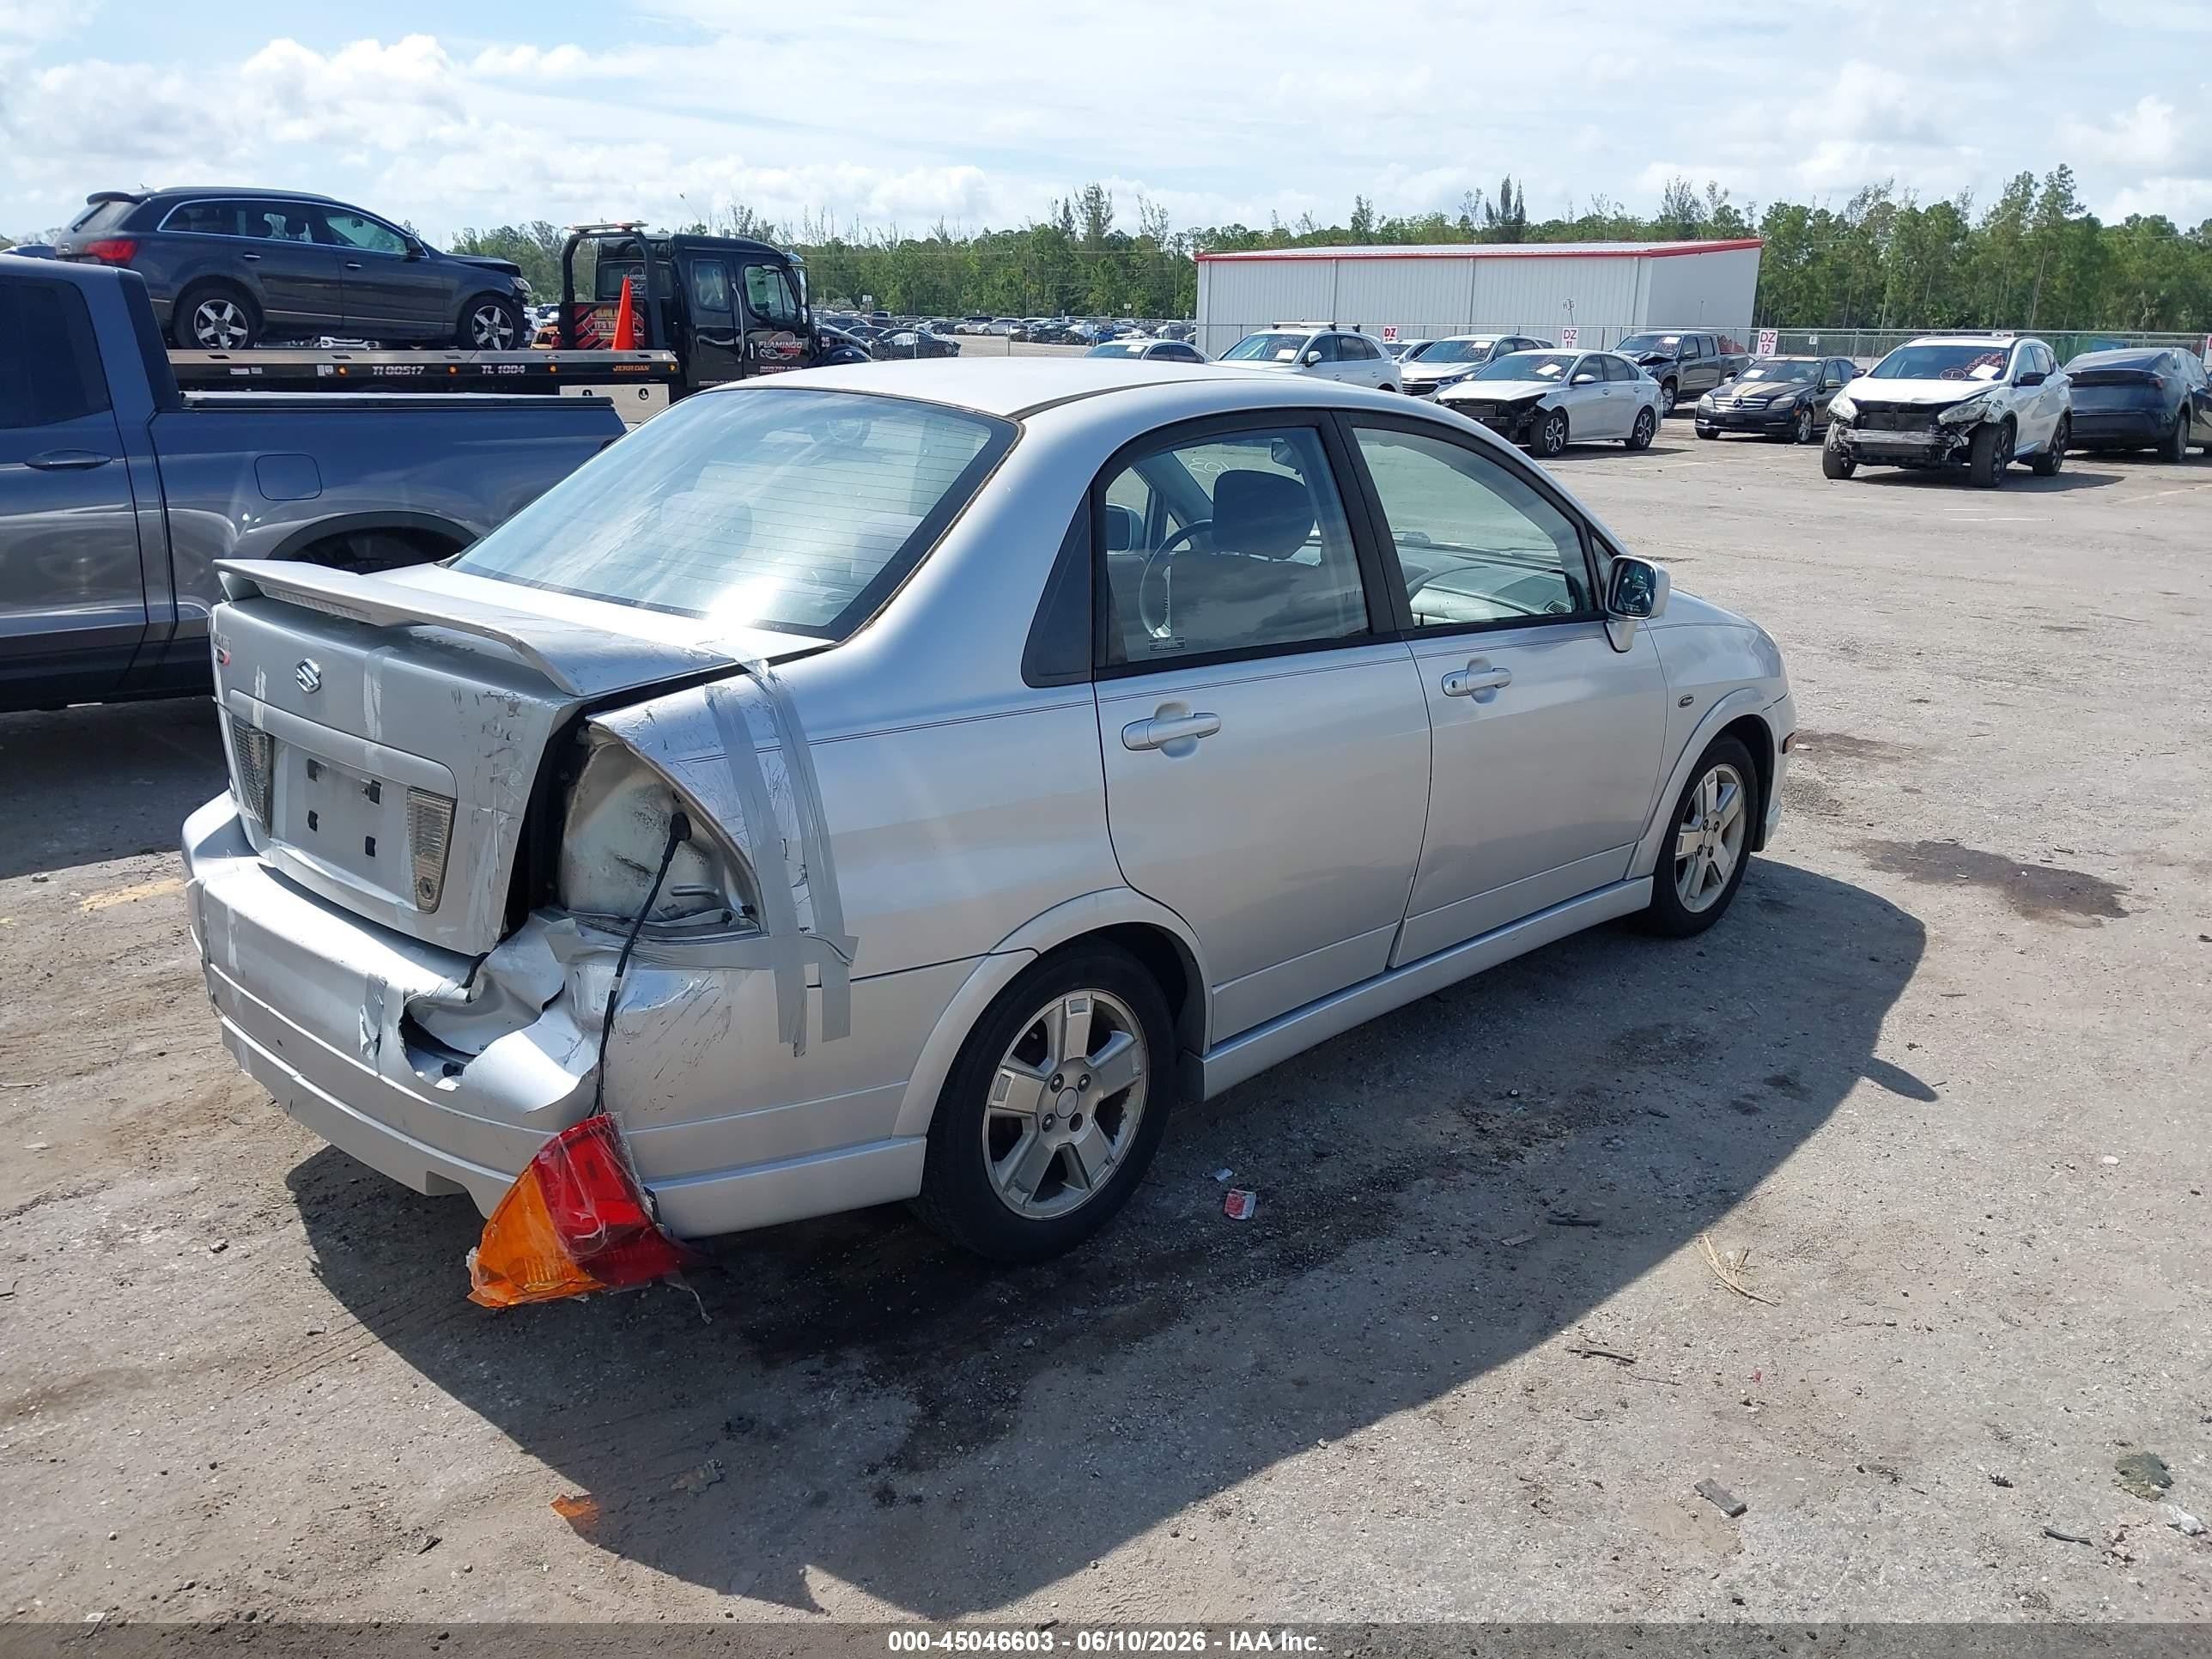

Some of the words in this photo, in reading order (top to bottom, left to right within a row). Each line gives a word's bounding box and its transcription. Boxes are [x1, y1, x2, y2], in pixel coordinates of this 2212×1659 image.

[1384, 328, 1397, 337] DZ
[1564, 330, 1577, 339] DZ
[1760, 331, 1777, 343] DZ
[1761, 343, 1771, 354] 12
